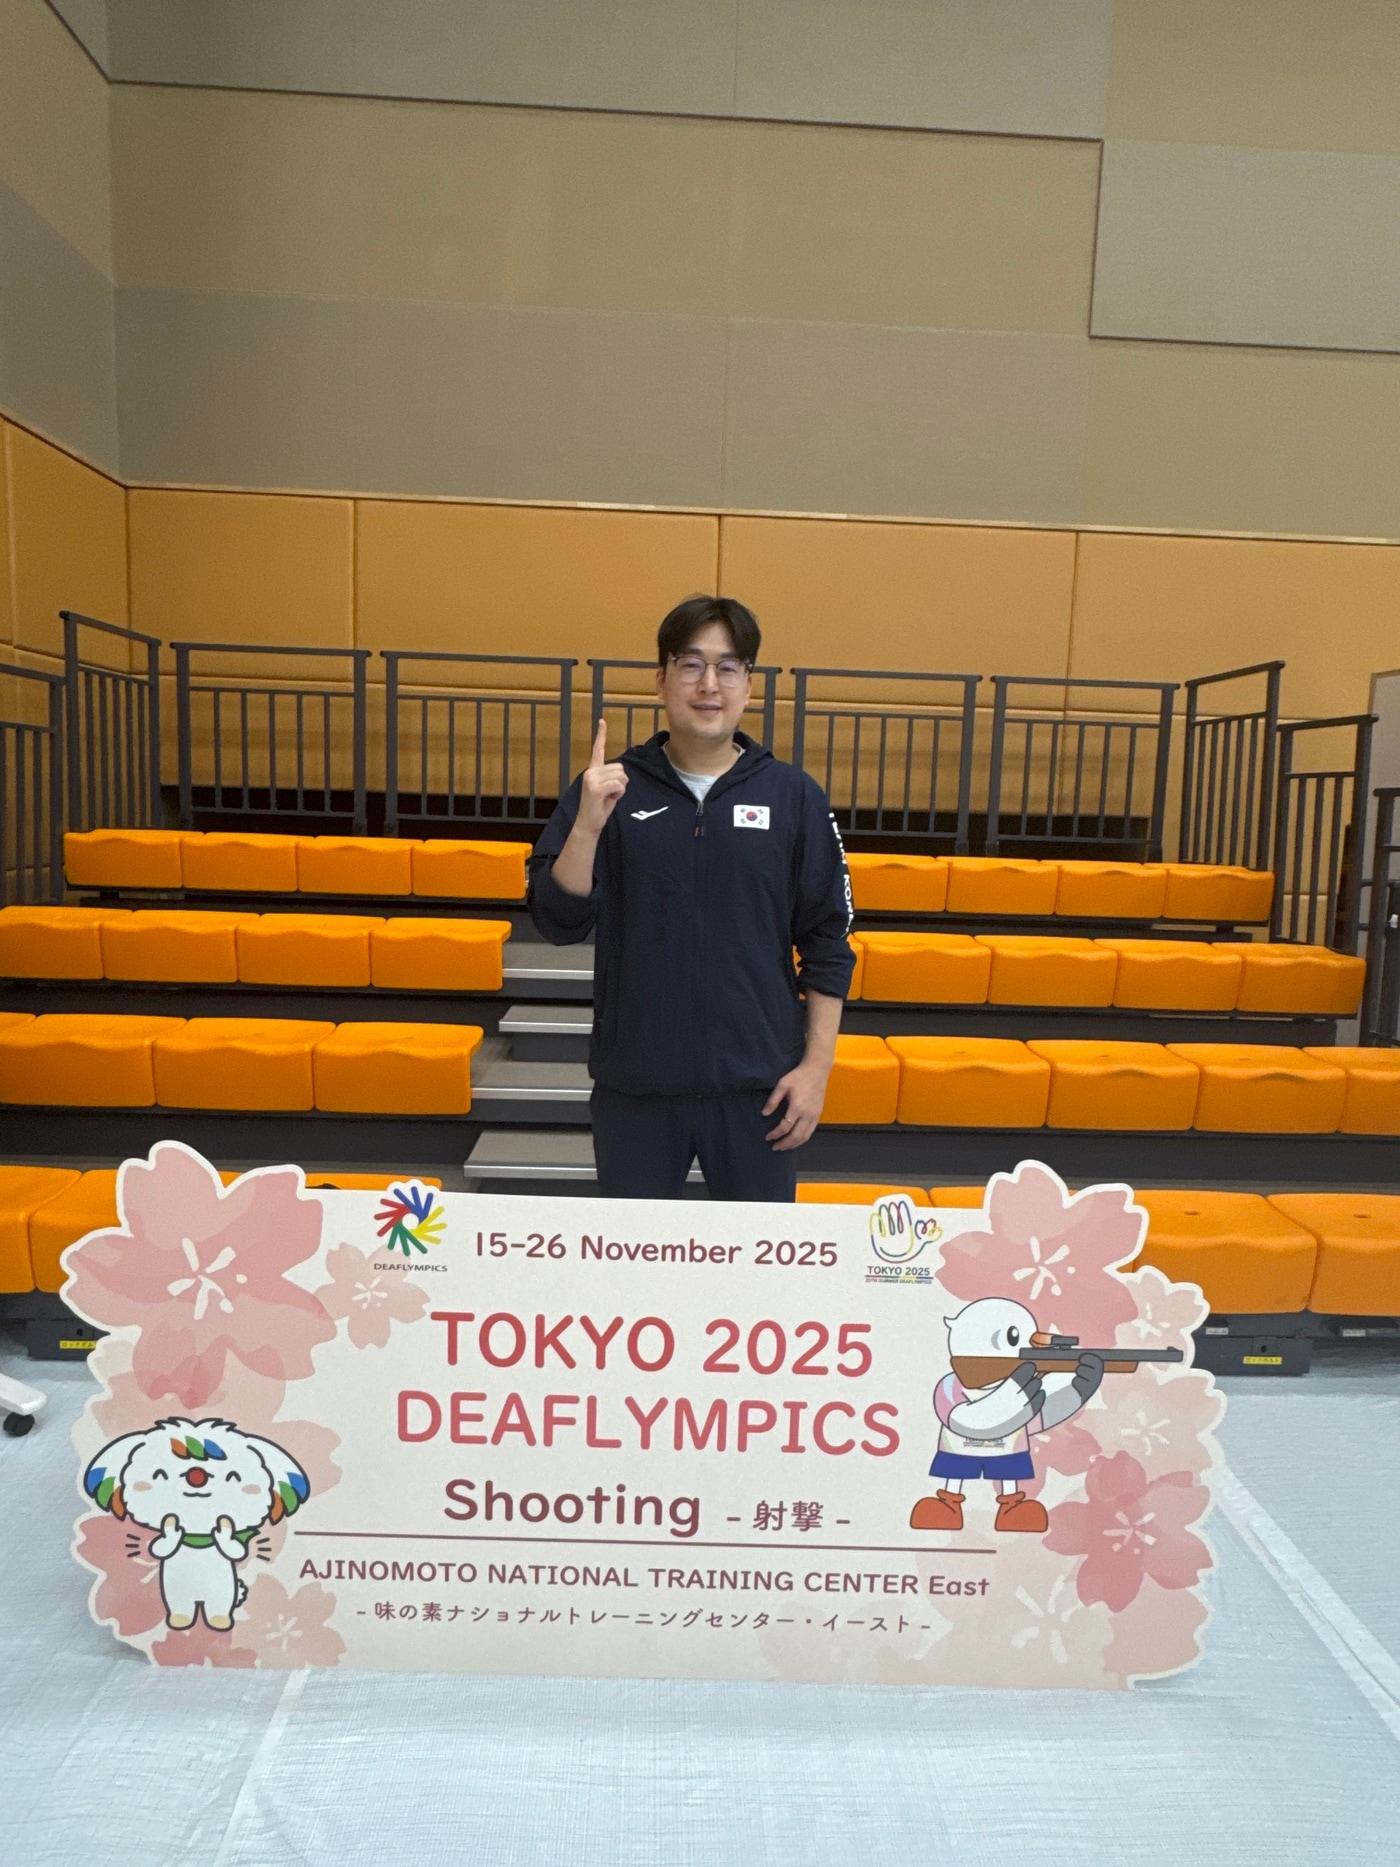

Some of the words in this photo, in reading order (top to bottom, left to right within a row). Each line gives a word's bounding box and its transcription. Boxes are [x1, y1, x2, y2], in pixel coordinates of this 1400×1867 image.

[374, 1263, 448, 1272] DEAFLYMPICS
[476, 1231, 567, 1260] 15-26
[580, 1234, 743, 1265] November
[754, 1239, 838, 1268] 2025
[866, 1265, 902, 1276] TOKYO
[905, 1266, 930, 1277] 2025
[429, 1310, 676, 1373] TOKYO
[702, 1318, 873, 1378] 2025
[397, 1389, 901, 1457] DEAFLYMPICS
[443, 1478, 701, 1539] Shooting
[751, 1499, 825, 1533] 射撃
[298, 1558, 478, 1585] AJINOMOTO
[488, 1562, 639, 1588] NATIONAL
[647, 1567, 794, 1592] TRAINING
[803, 1571, 919, 1595] CENTER
[928, 1575, 991, 1597] East
